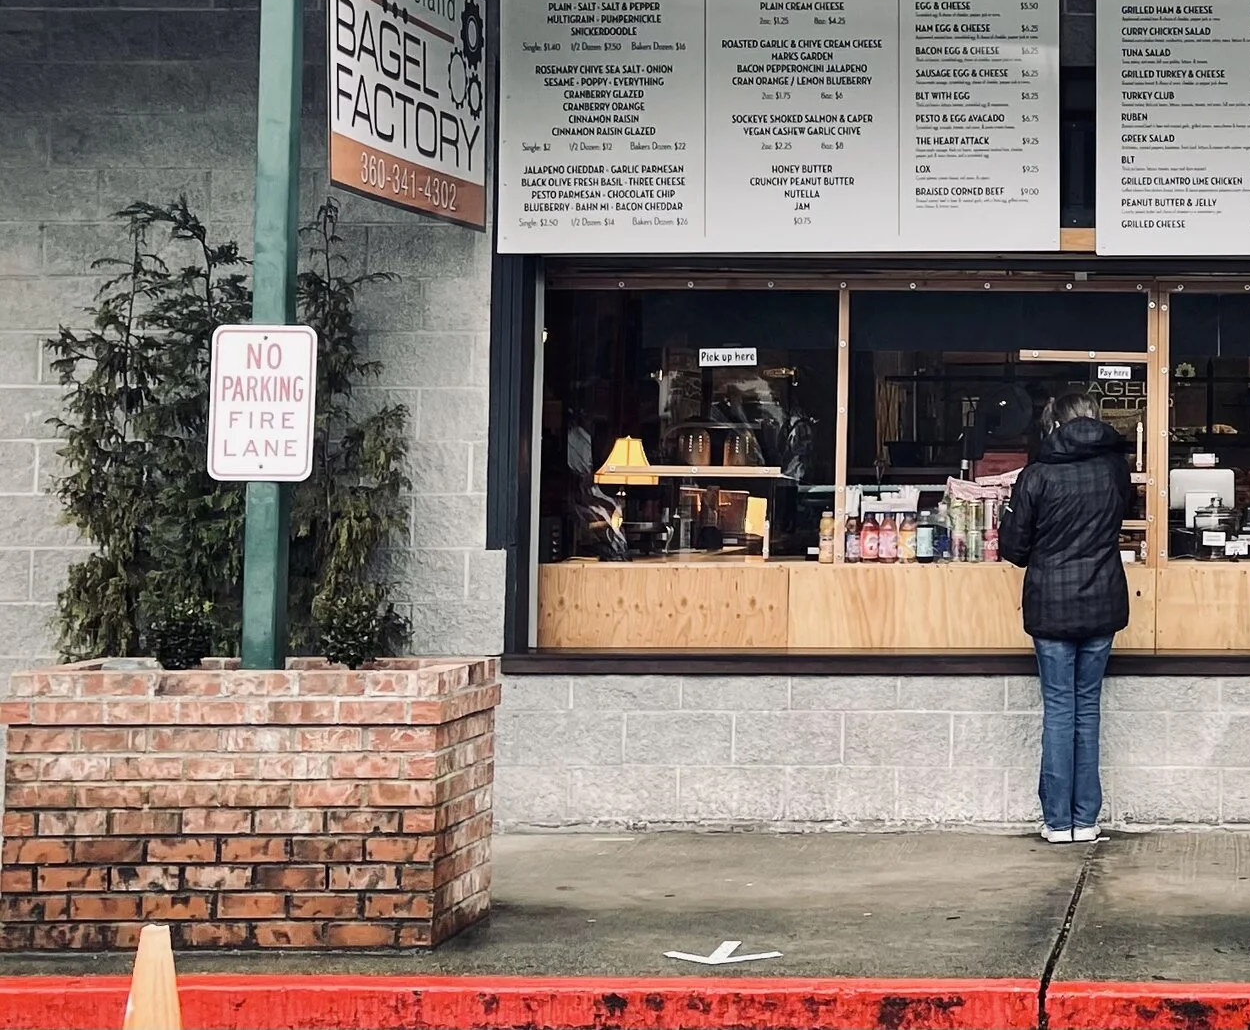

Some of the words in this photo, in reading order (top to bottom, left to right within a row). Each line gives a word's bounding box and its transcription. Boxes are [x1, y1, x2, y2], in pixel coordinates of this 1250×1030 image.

[760, 2, 784, 11] PLAIN
[785, 2, 813, 11] CREAM
[814, 2, 844, 11] CHEESE
[571, 27, 637, 36] SNICKERDOODLE
[1122, 49, 1143, 57] TUNA
[1145, 49, 1171, 57] SALAD
[564, 90, 611, 99] CRANBERRY
[613, 90, 644, 99] GLAZED
[1122, 92, 1152, 100] TURKEY
[1154, 92, 1175, 100] CLUB
[563, 102, 610, 111] CRANBERRY
[612, 102, 645, 111] ORANGE
[336, 63, 480, 171] FACTORY
[916, 114, 940, 122] PESTO
[942, 114, 948, 122] &
[950, 114, 966, 122] EGG
[968, 114, 1005, 122] AVACADO
[1121, 113, 1148, 121] RUBEN
[552, 127, 595, 136] CINNAMON
[597, 127, 623, 136] RAISIN
[625, 127, 656, 135] GLAZED
[916, 137, 931, 145] THE
[933, 137, 959, 145] HEART
[961, 137, 989, 145] ATTACK
[1022, 137, 1039, 145] $9.25
[772, 165, 800, 173] HONEY
[802, 165, 833, 173] BUTTER
[916, 165, 931, 173] LOX
[1023, 166, 1039, 174] $9.25
[361, 152, 458, 212] 360-341-4302
[750, 178, 787, 186] CRUNCHY
[790, 178, 821, 186] PEANUT
[532, 191, 557, 199] PESTO
[559, 191, 601, 199] PARMESAN
[607, 190, 654, 199] CHOCOLATE
[657, 190, 676, 198] CHIP
[784, 190, 820, 198] NUTELLA
[794, 203, 810, 211] JAM
[246, 343, 282, 370] NO
[702, 352, 720, 362] Pick
[722, 354, 732, 362] up
[735, 352, 755, 361] here
[1100, 369, 1112, 377] Pay
[222, 376, 304, 402] PARKING
[229, 412, 295, 429] FIRE
[224, 440, 297, 457] LANE
